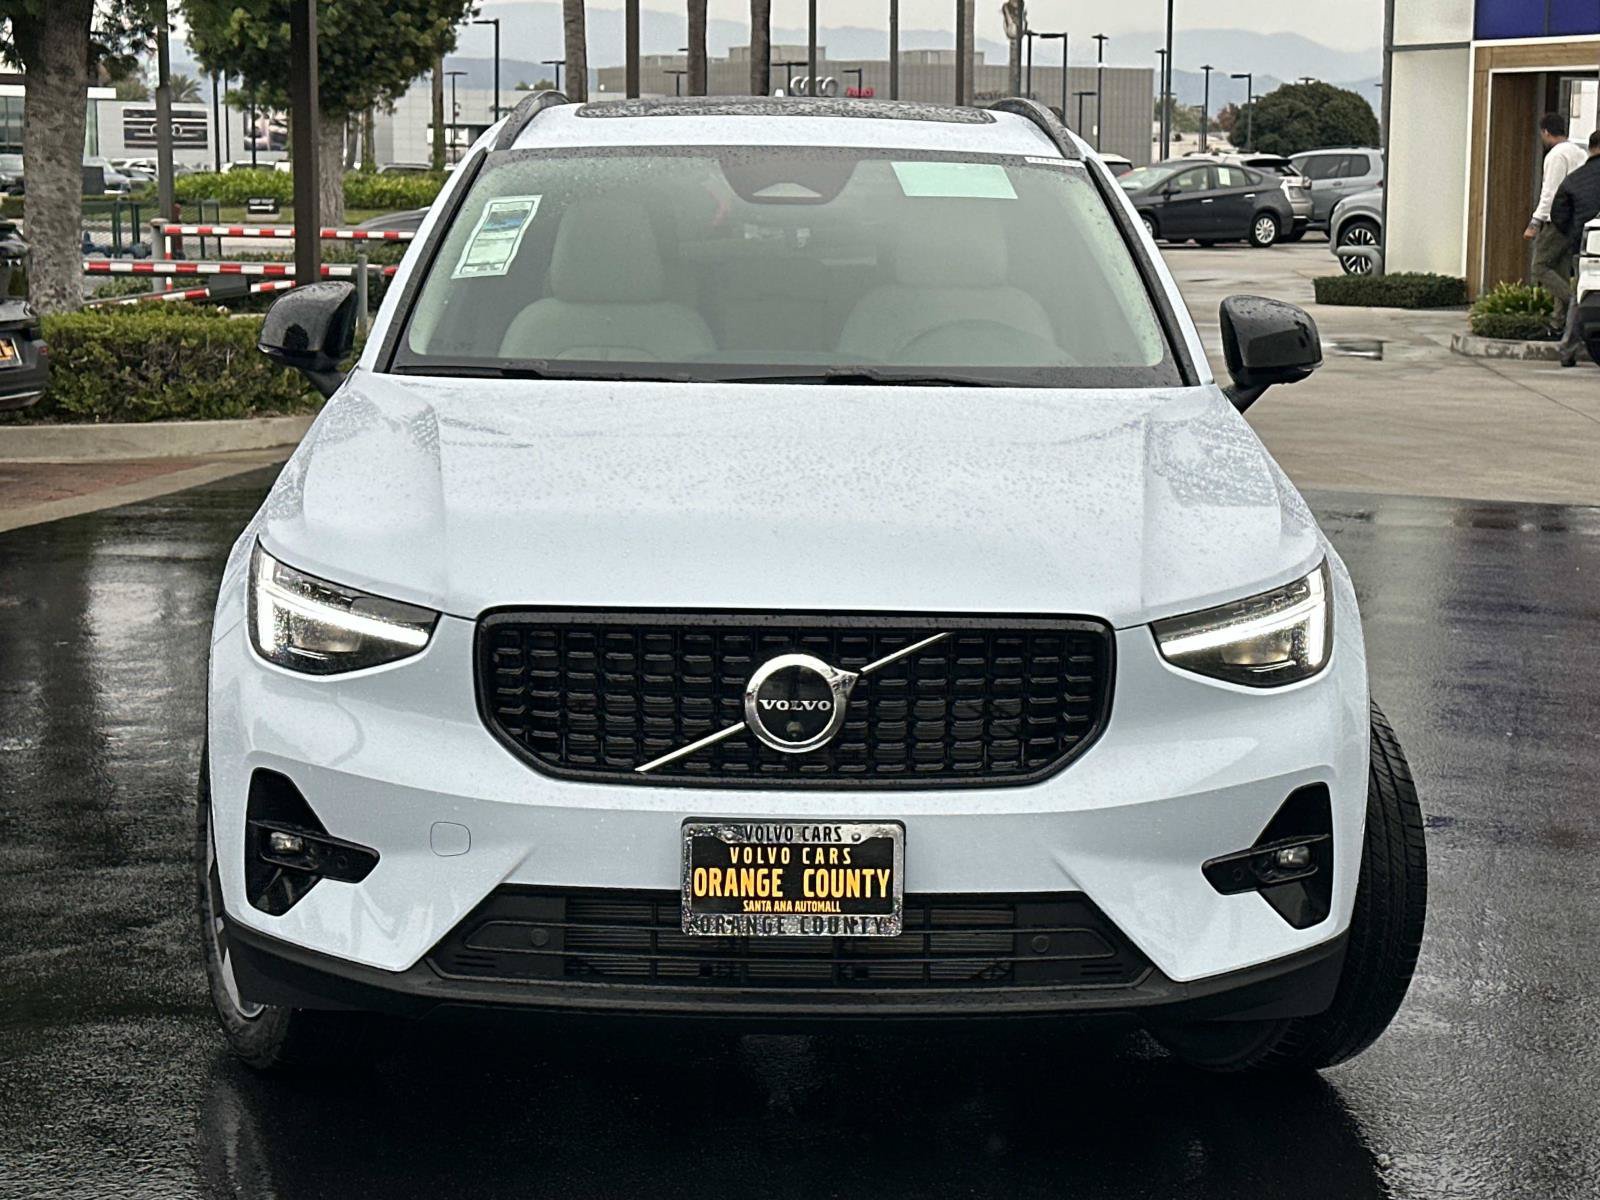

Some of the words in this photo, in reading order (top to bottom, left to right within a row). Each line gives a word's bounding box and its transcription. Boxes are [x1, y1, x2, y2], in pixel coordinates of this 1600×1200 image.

[759, 699, 832, 711] VOLVO
[744, 826, 794, 842] VOLVO
[802, 826, 842, 842] CARS
[729, 847, 790, 864] VOLVO
[802, 847, 852, 865] CARS
[693, 867, 784, 897] ORANGE
[803, 868, 891, 898] COUNTY
[743, 900, 772, 912] SANTA
[774, 900, 792, 912] ANA
[794, 900, 841, 913] AUTOMALL
[700, 915, 785, 934] ORANGE
[800, 915, 885, 935] COUNTY
